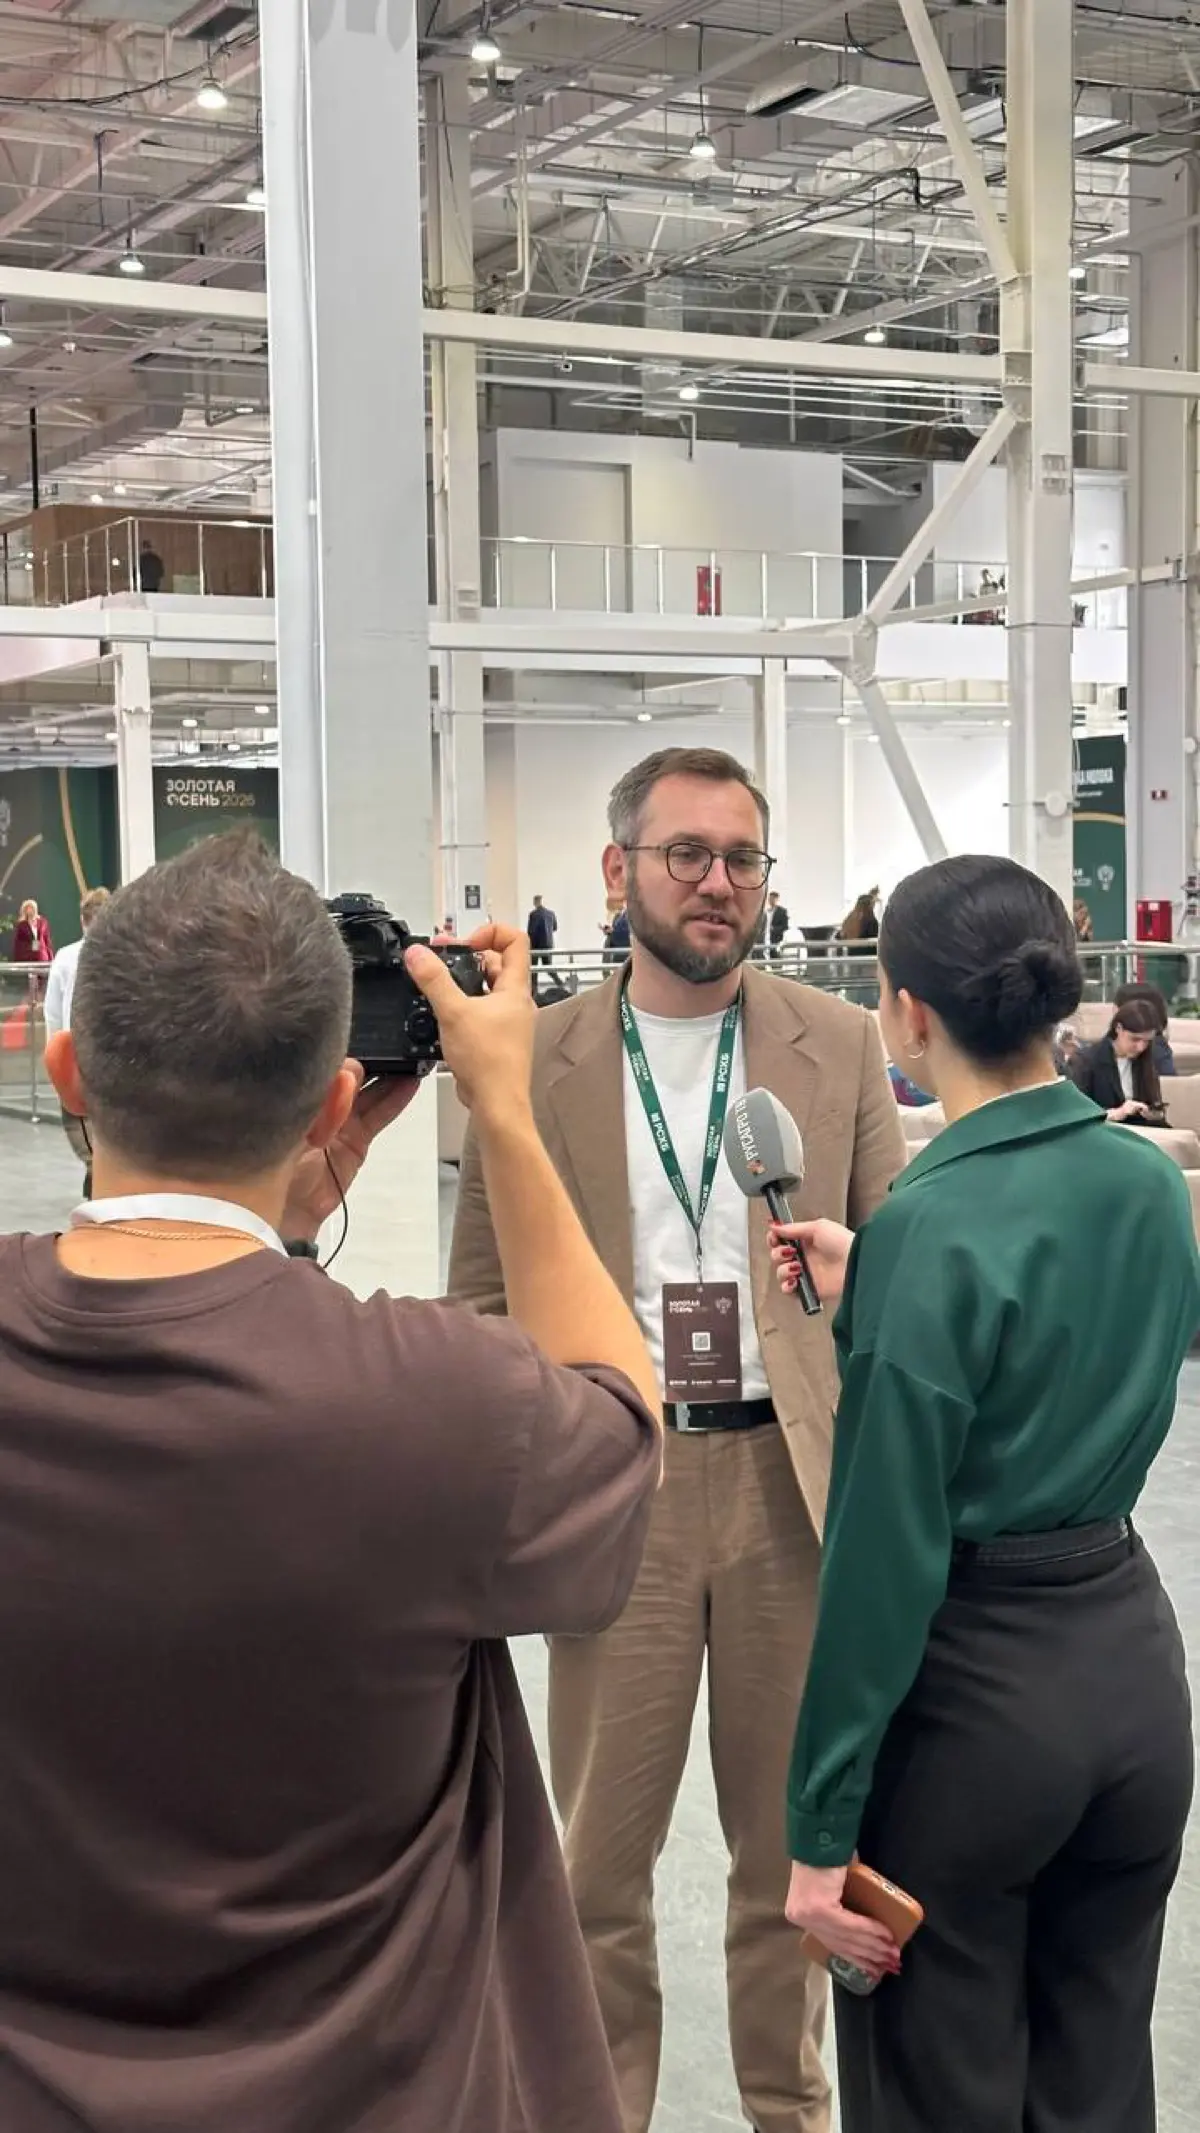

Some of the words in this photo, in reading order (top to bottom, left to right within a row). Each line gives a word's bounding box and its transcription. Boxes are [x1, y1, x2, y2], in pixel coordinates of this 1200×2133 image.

[166, 779, 236, 793] ЗОЛОТАЯ
[166, 793, 220, 806] ОСЕНЬ
[717, 1052, 730, 1083] РСХБ
[656, 1122, 670, 1152] РСХБ
